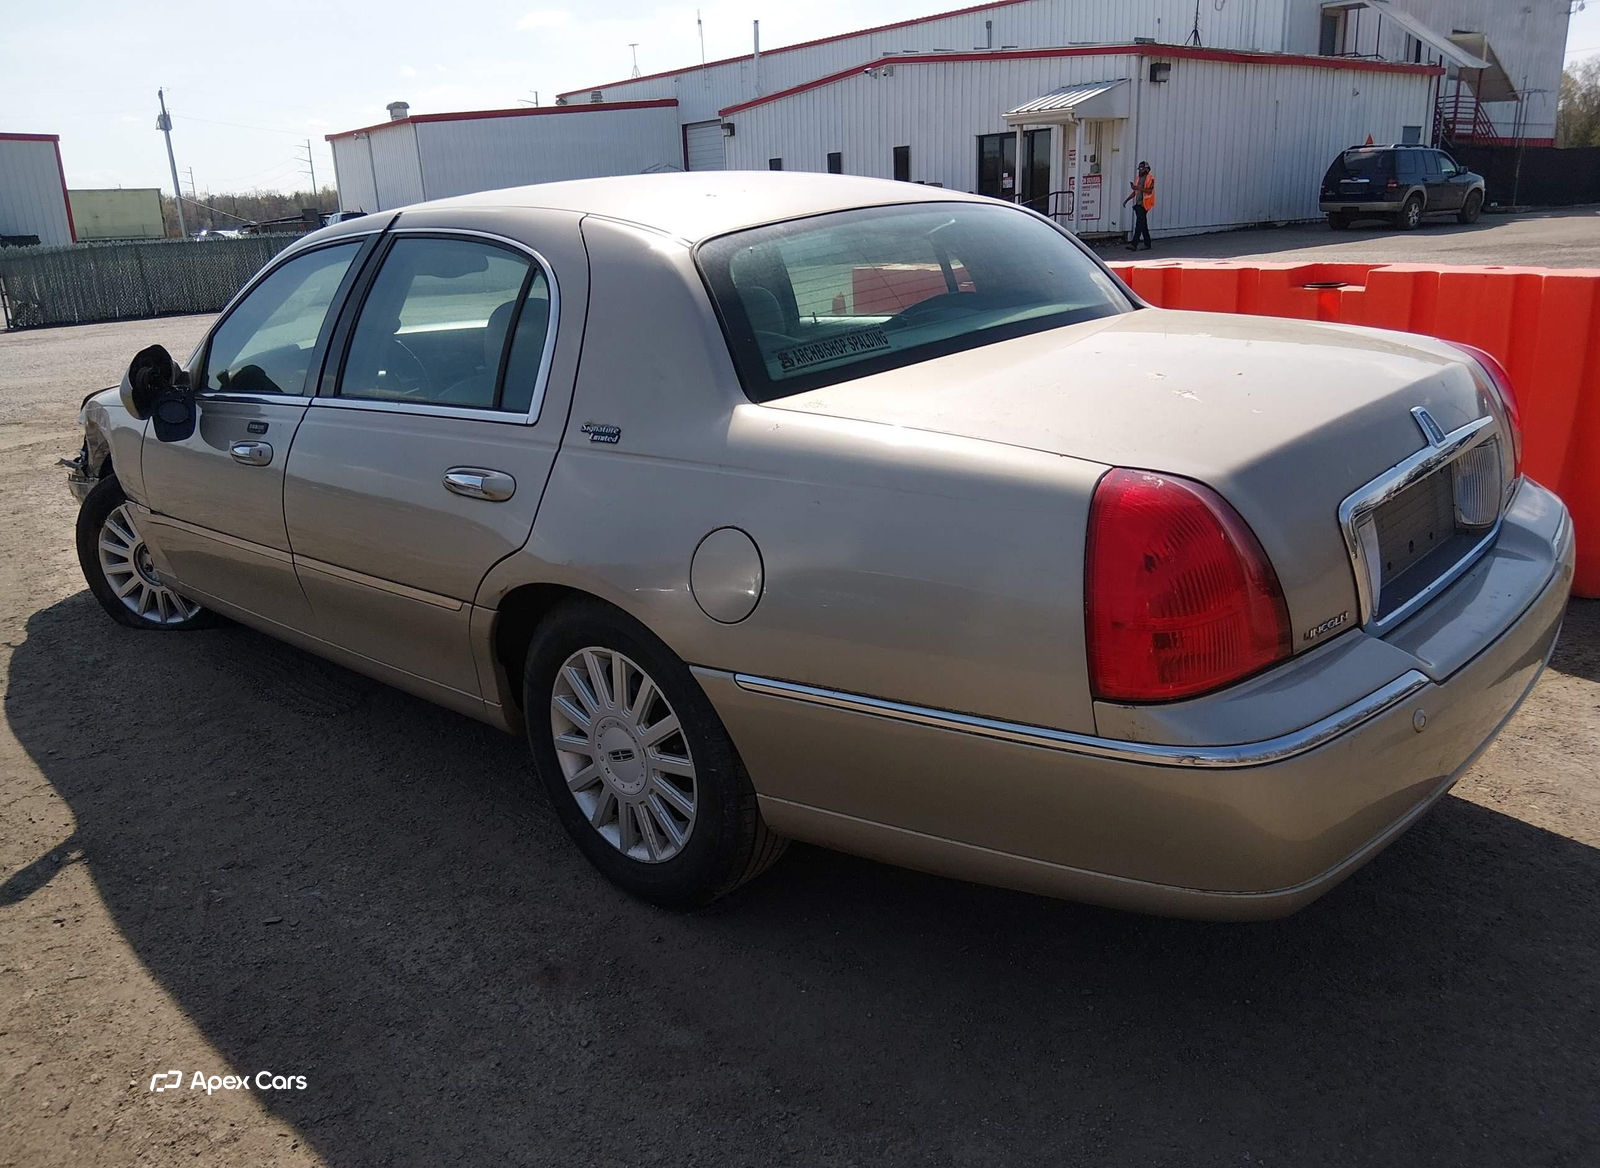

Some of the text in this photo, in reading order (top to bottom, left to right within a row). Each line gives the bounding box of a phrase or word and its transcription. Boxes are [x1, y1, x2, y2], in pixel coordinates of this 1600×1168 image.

[792, 338, 848, 365] ARCHBISHOP
[846, 330, 889, 352] SPALDING
[581, 423, 619, 435] Signature
[589, 432, 619, 443] Limited
[1303, 611, 1349, 641] LINCOLN
